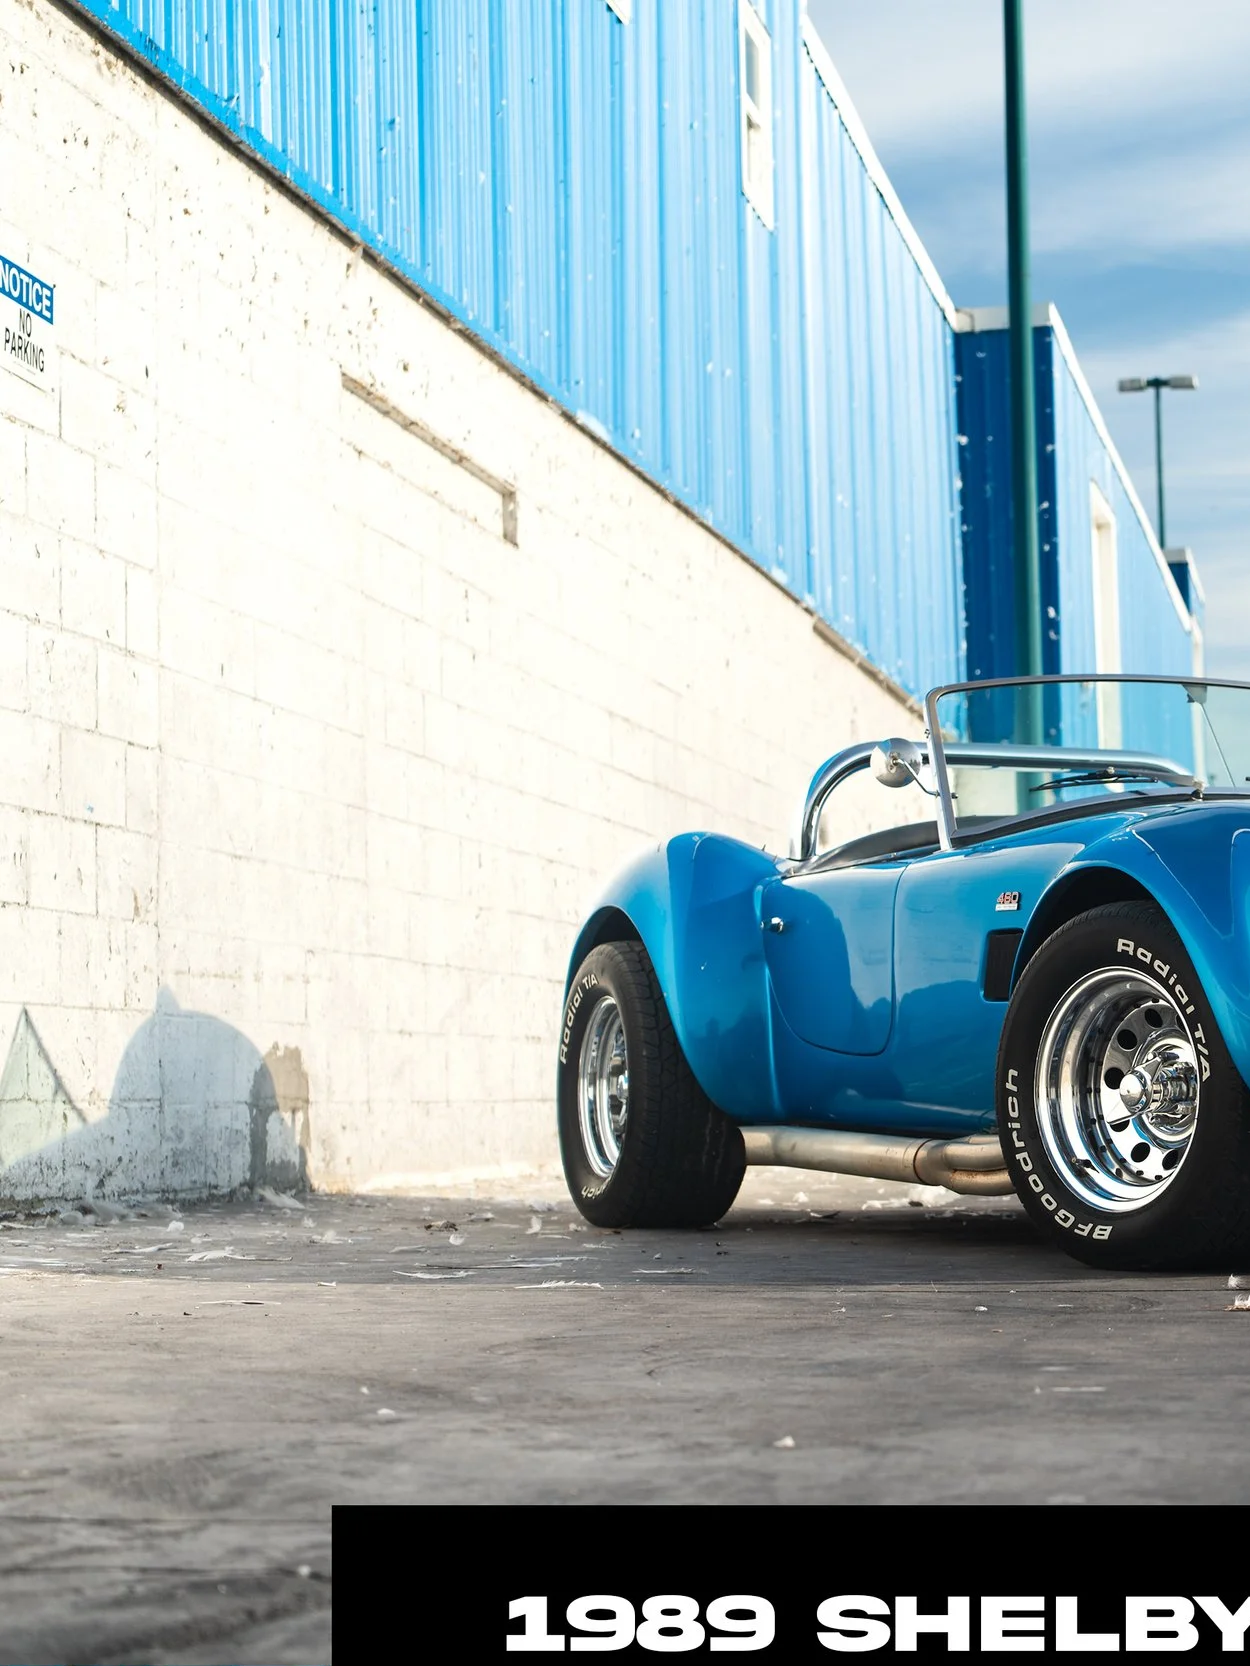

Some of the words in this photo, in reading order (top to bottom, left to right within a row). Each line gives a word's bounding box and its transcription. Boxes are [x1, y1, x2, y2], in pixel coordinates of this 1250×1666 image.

[0, 261, 51, 319] NOTICE
[19, 308, 32, 338] NO
[4, 327, 44, 373] PARKING
[560, 986, 583, 1064] Radial
[582, 973, 598, 990] T/A
[1116, 938, 1195, 1015] Radial
[1194, 1023, 1211, 1083] T/A
[1005, 1068, 1113, 1240] BFGoodrich
